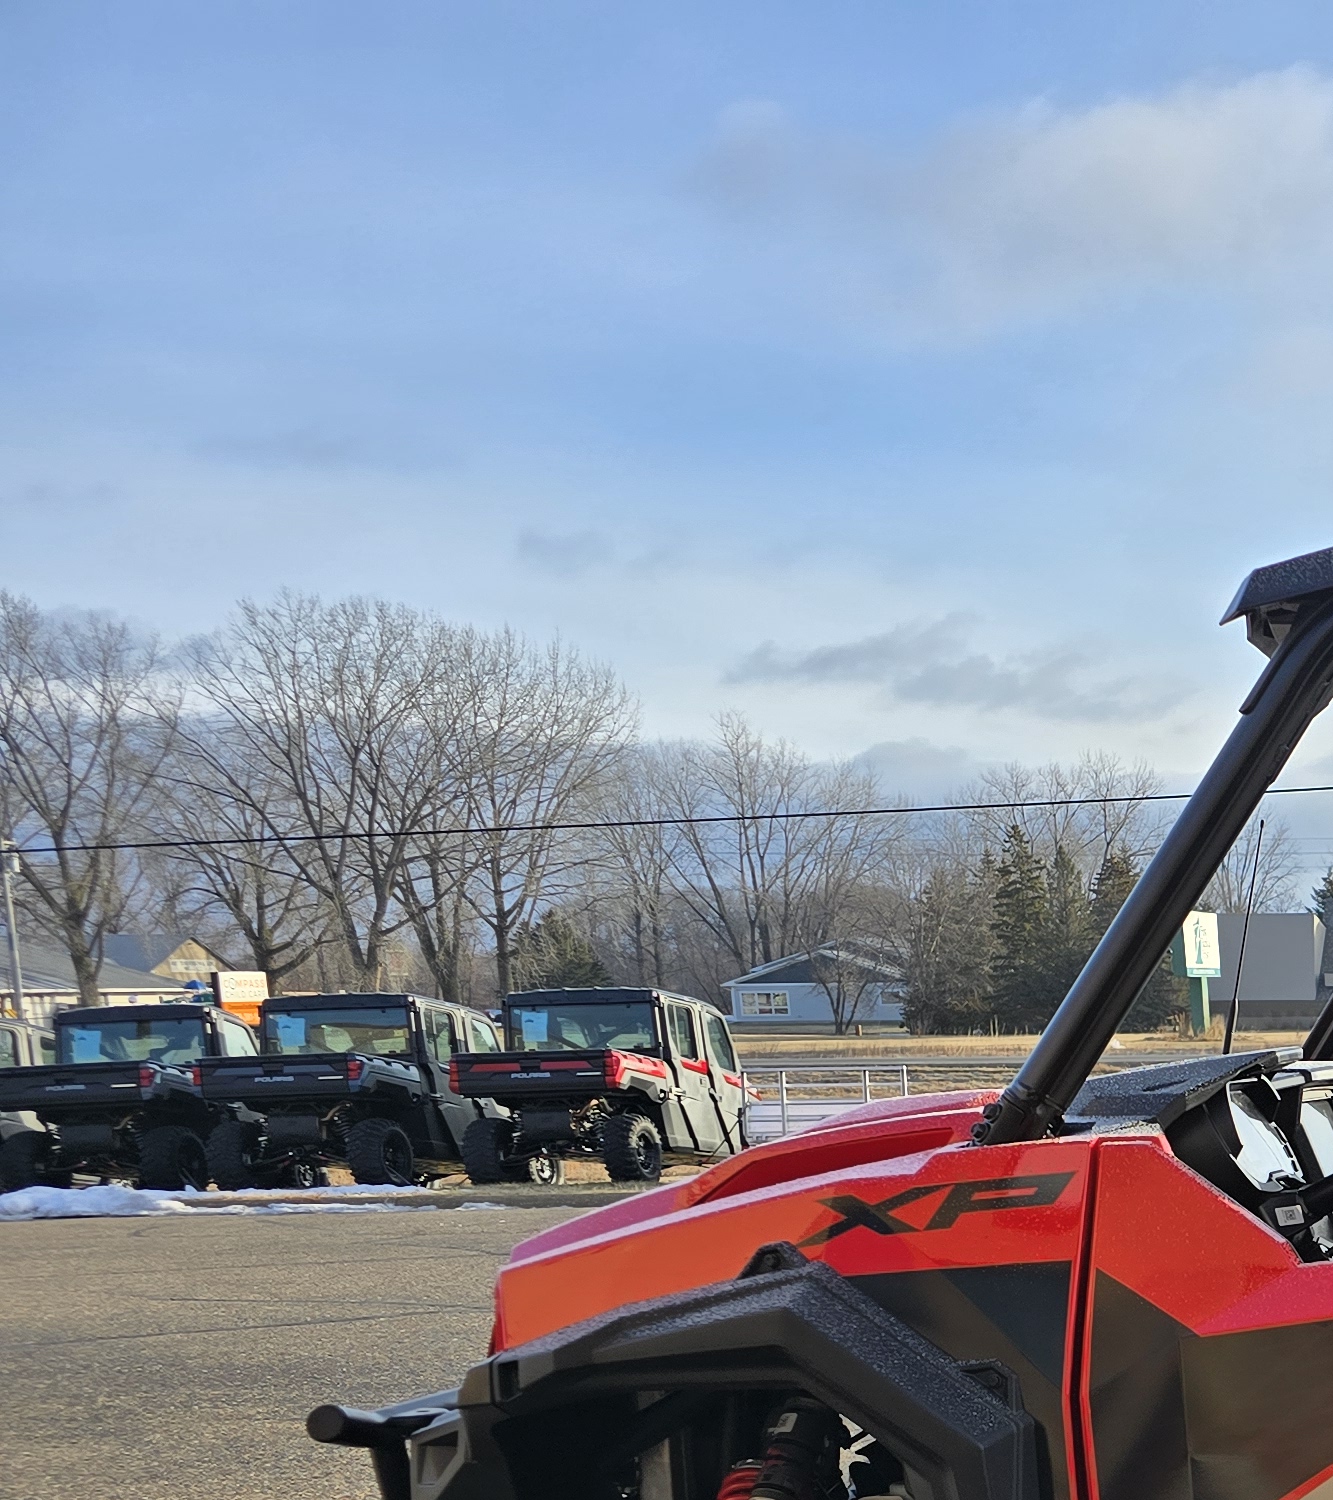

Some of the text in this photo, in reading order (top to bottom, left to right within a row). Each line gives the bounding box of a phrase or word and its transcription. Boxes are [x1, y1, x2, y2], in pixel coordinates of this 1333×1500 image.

[223, 977, 265, 990] COMPASS
[254, 1075, 294, 1083] POLARIS
[796, 1170, 1078, 1248] XP
